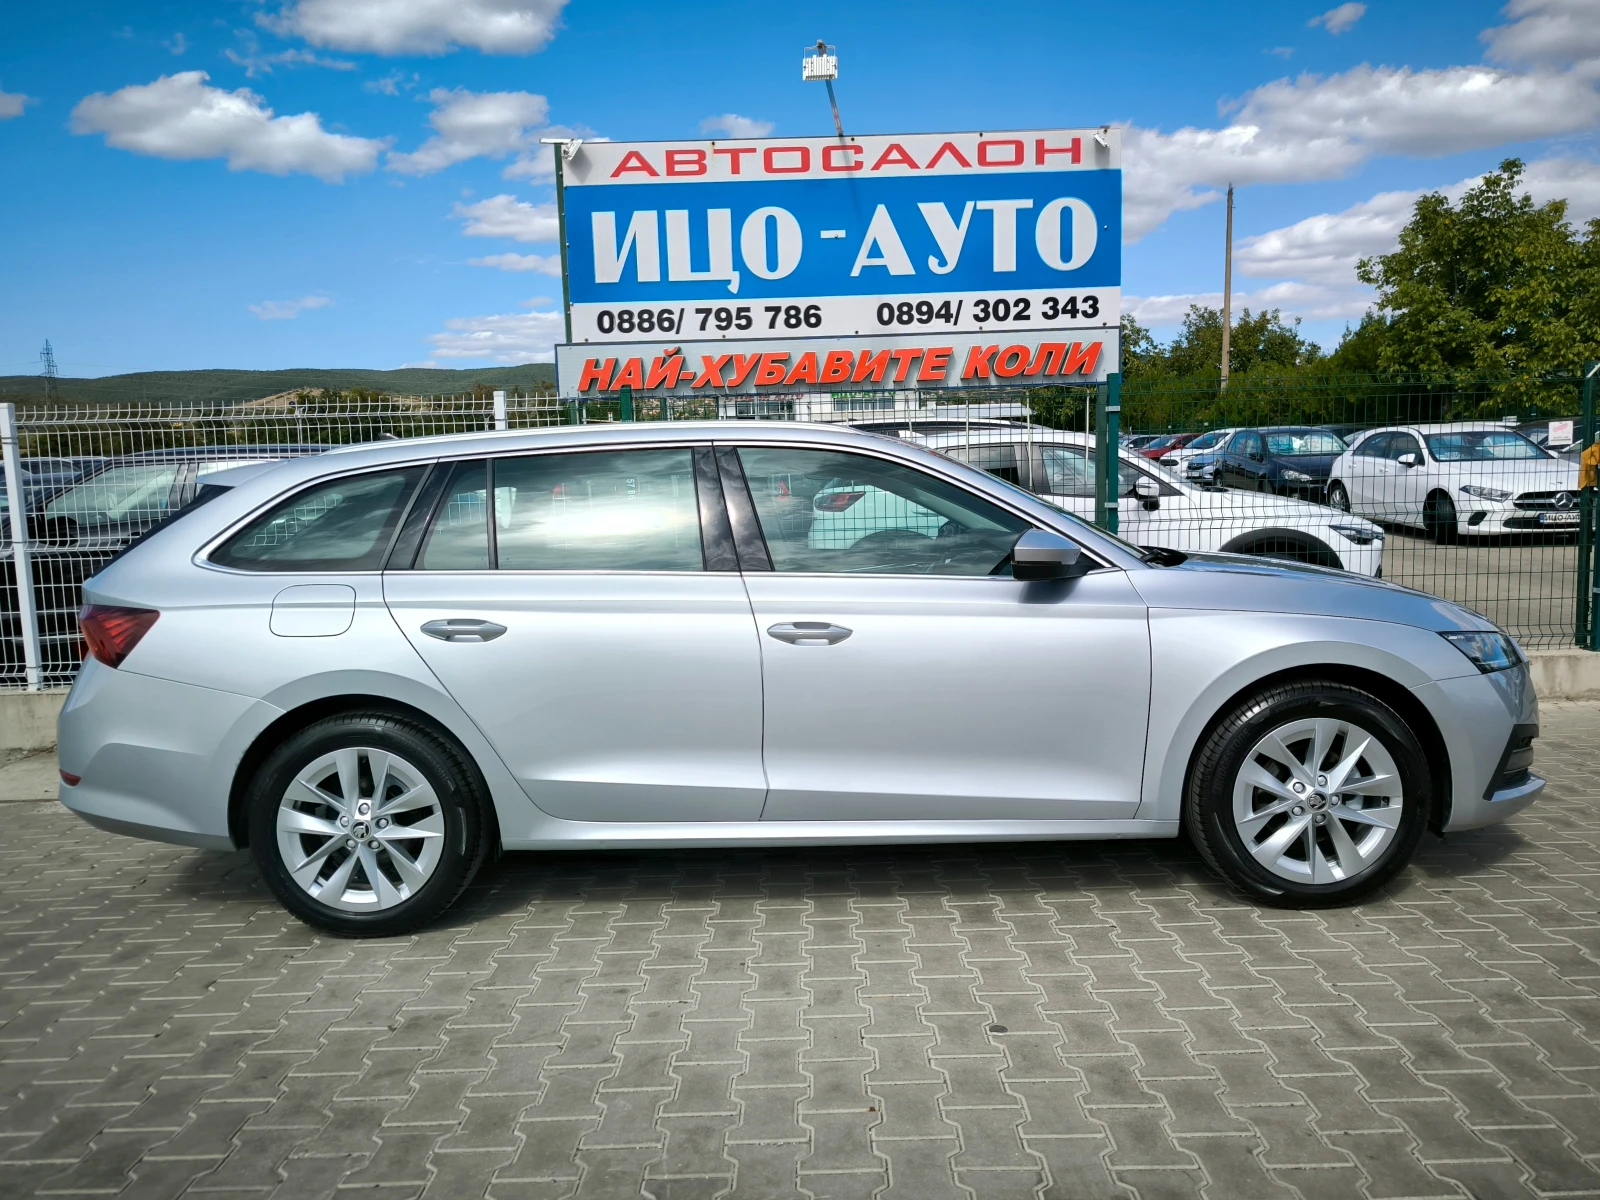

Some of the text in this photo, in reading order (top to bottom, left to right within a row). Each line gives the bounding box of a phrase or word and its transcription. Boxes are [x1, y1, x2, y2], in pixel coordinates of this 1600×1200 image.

[611, 137, 1082, 178] АВТОСАЛОН
[596, 295, 1100, 335] 0886/ 795 786 0894/ 302 343
[578, 341, 1103, 391] НАЙ-ХУБАВИТЕ КОЛИ
